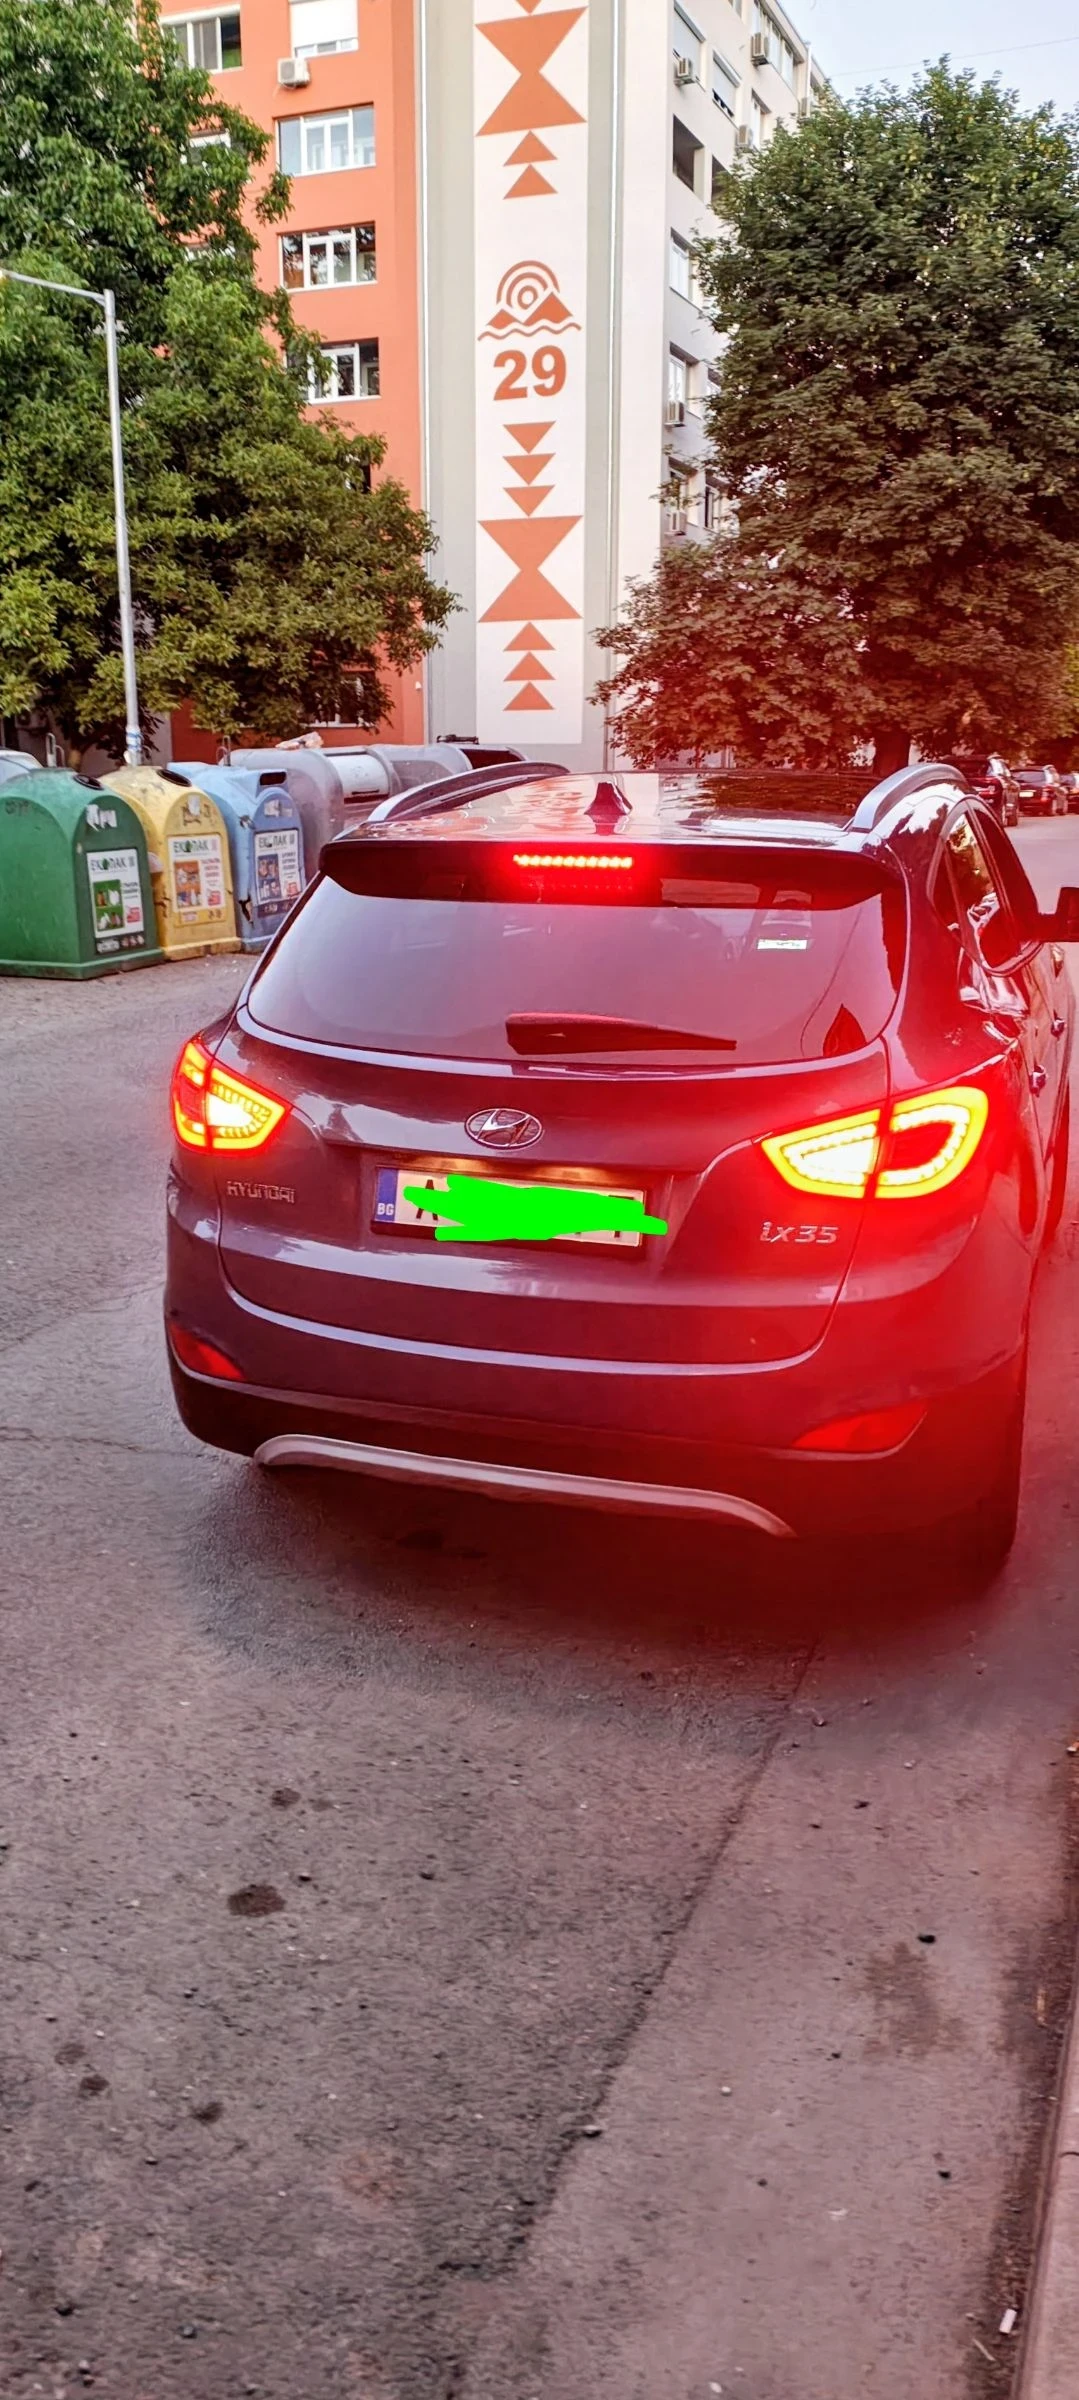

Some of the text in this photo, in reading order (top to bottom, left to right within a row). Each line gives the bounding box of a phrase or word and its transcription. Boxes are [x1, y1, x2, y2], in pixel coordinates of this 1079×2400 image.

[493, 345, 567, 401] 29
[227, 1181, 296, 1203] HYUNDAI
[377, 1203, 394, 1216] BG
